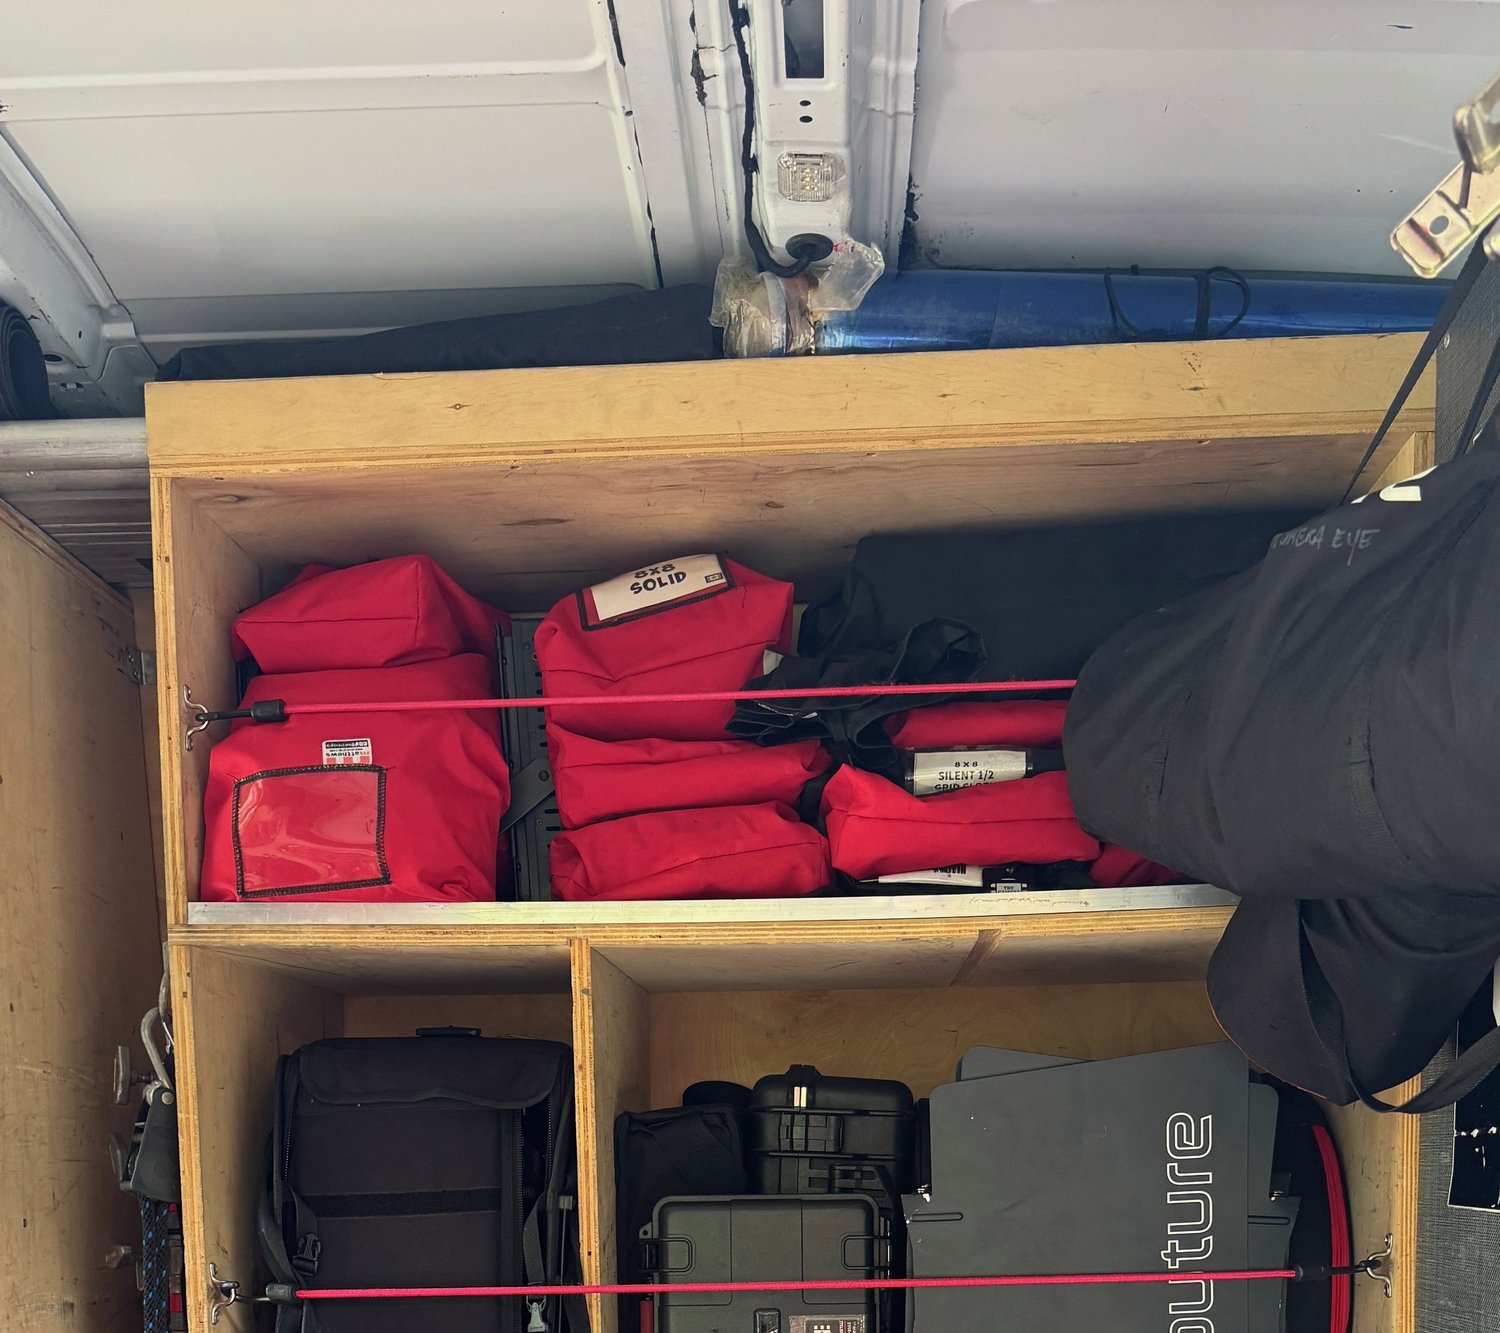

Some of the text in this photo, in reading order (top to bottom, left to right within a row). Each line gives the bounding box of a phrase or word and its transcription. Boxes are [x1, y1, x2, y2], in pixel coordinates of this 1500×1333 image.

[629, 571, 687, 595] SOLID
[938, 769, 994, 781] SILENT 1/2
